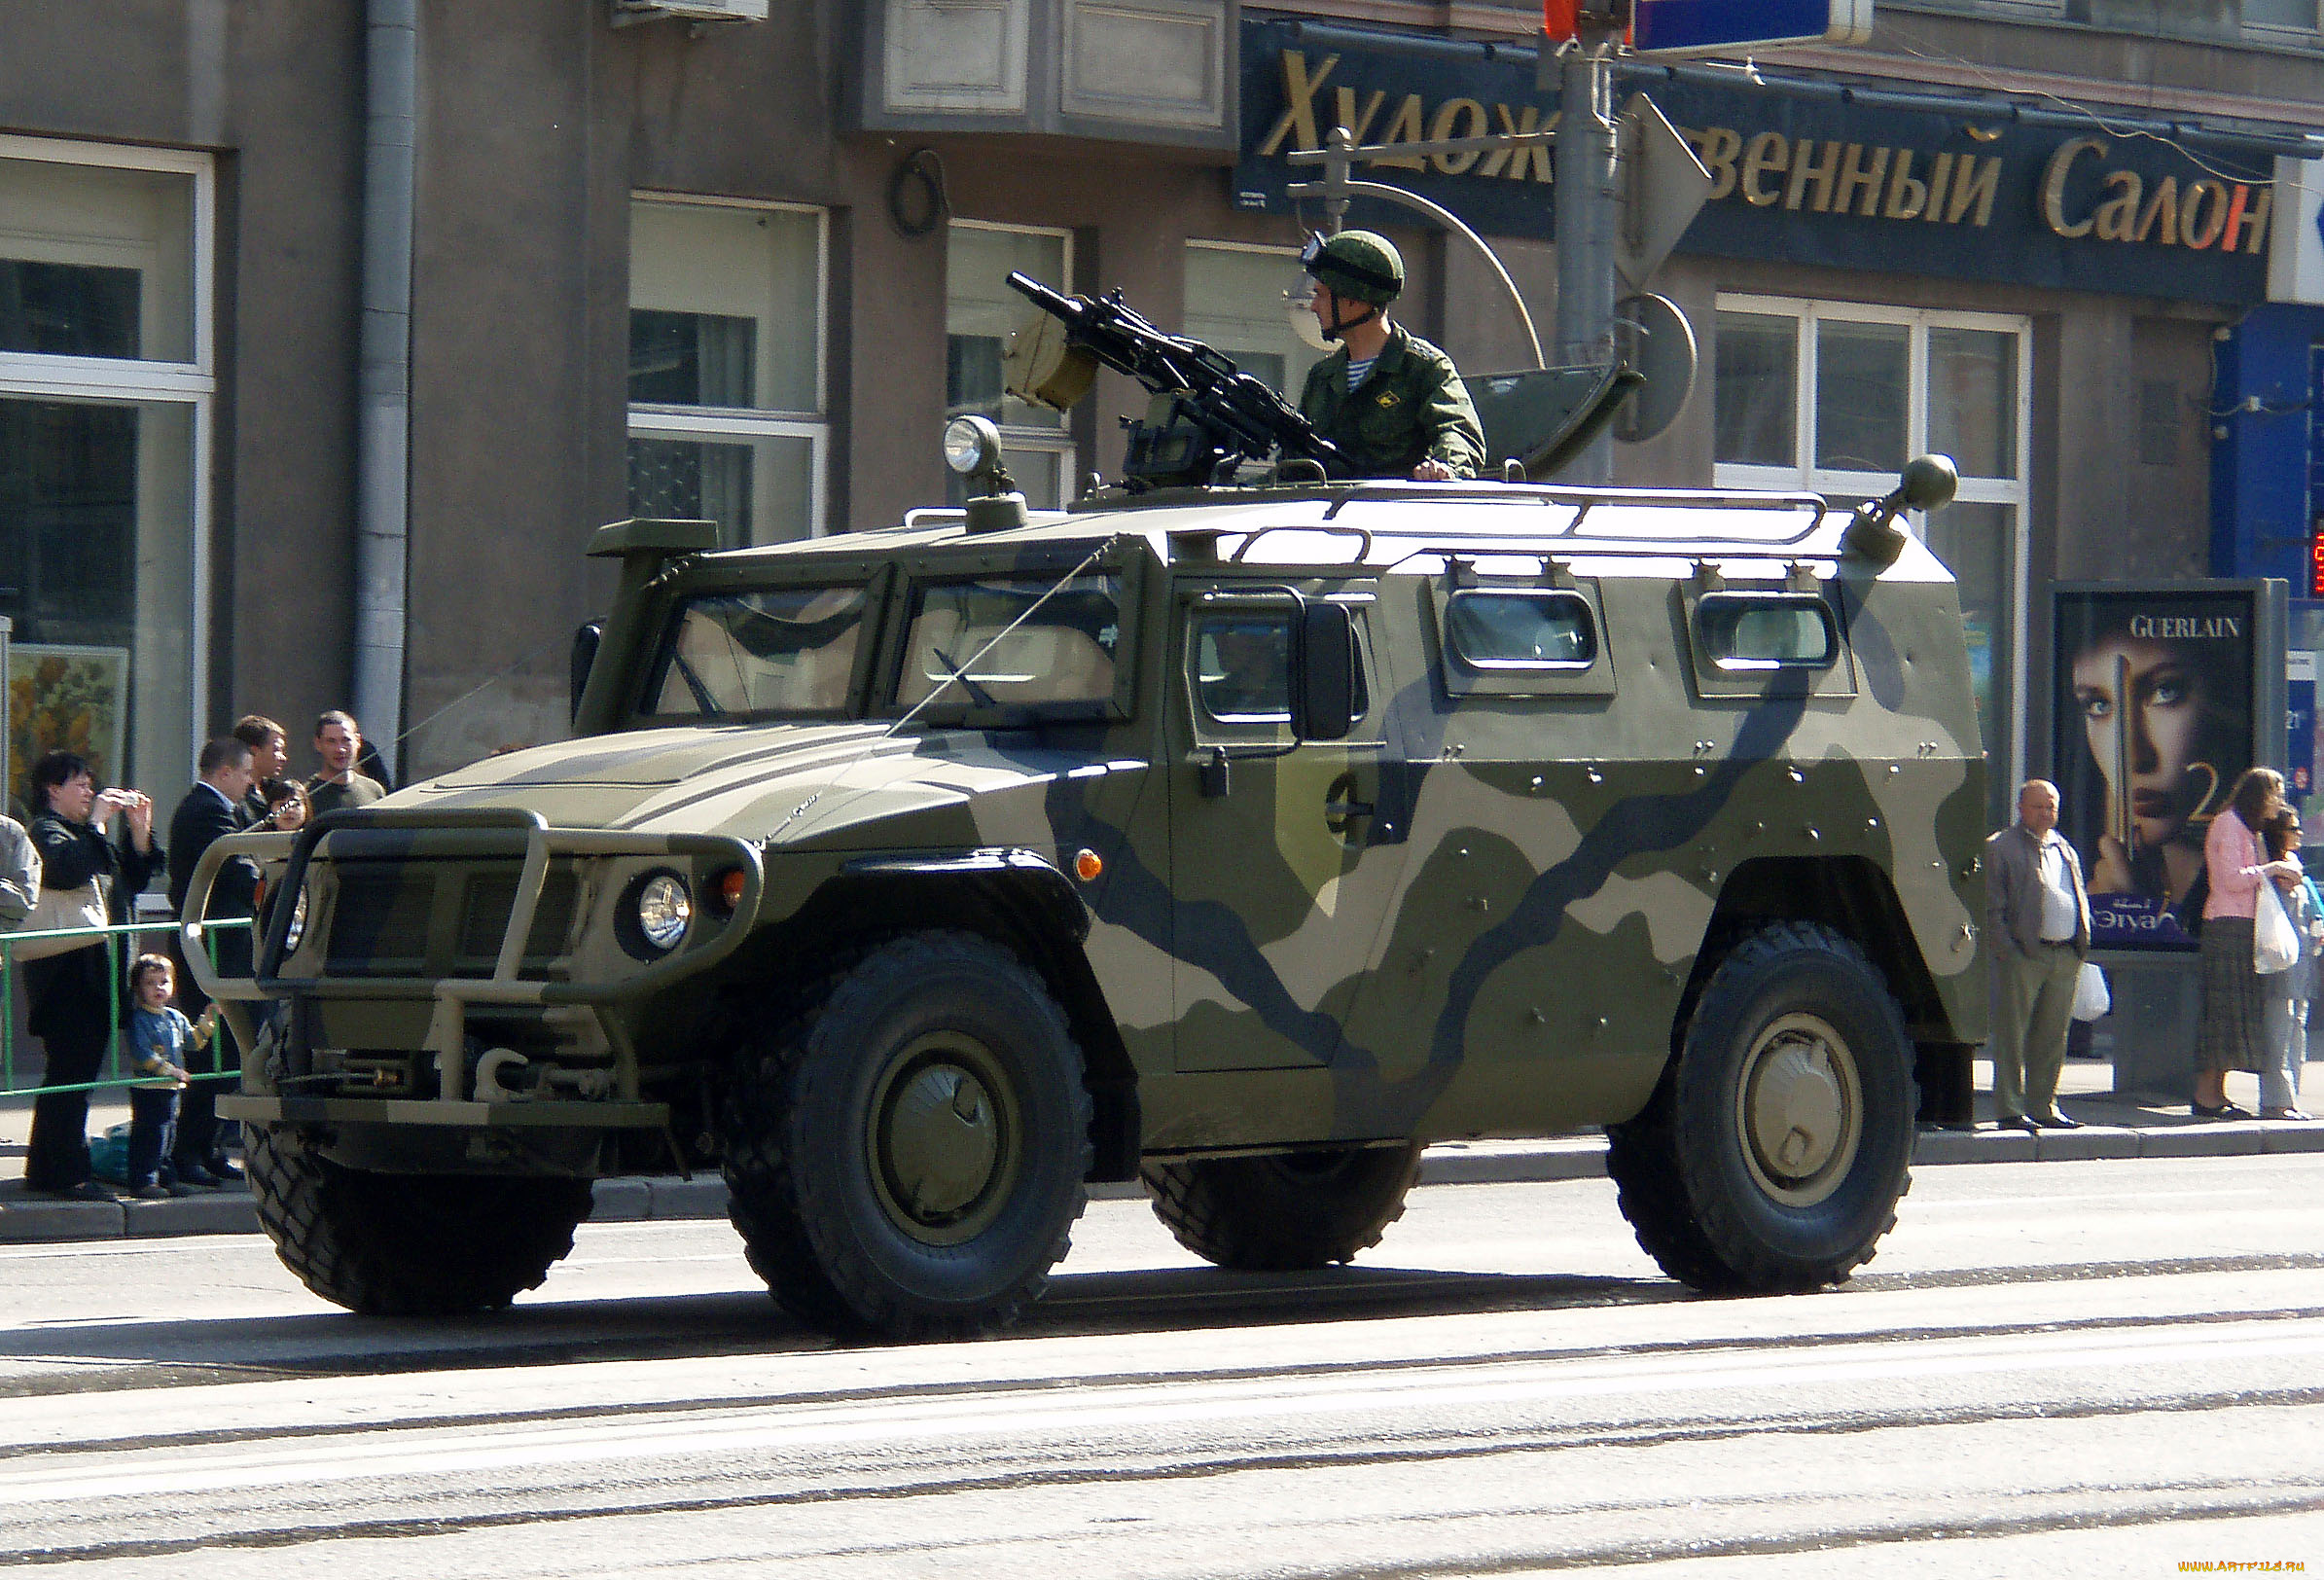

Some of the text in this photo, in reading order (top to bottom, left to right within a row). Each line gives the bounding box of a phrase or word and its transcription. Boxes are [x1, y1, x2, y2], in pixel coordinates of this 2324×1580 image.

[1262, 49, 2273, 255] Художвенный Салон
[2129, 615, 2240, 638] GUERLAIN
[2186, 761, 2219, 822] 2
